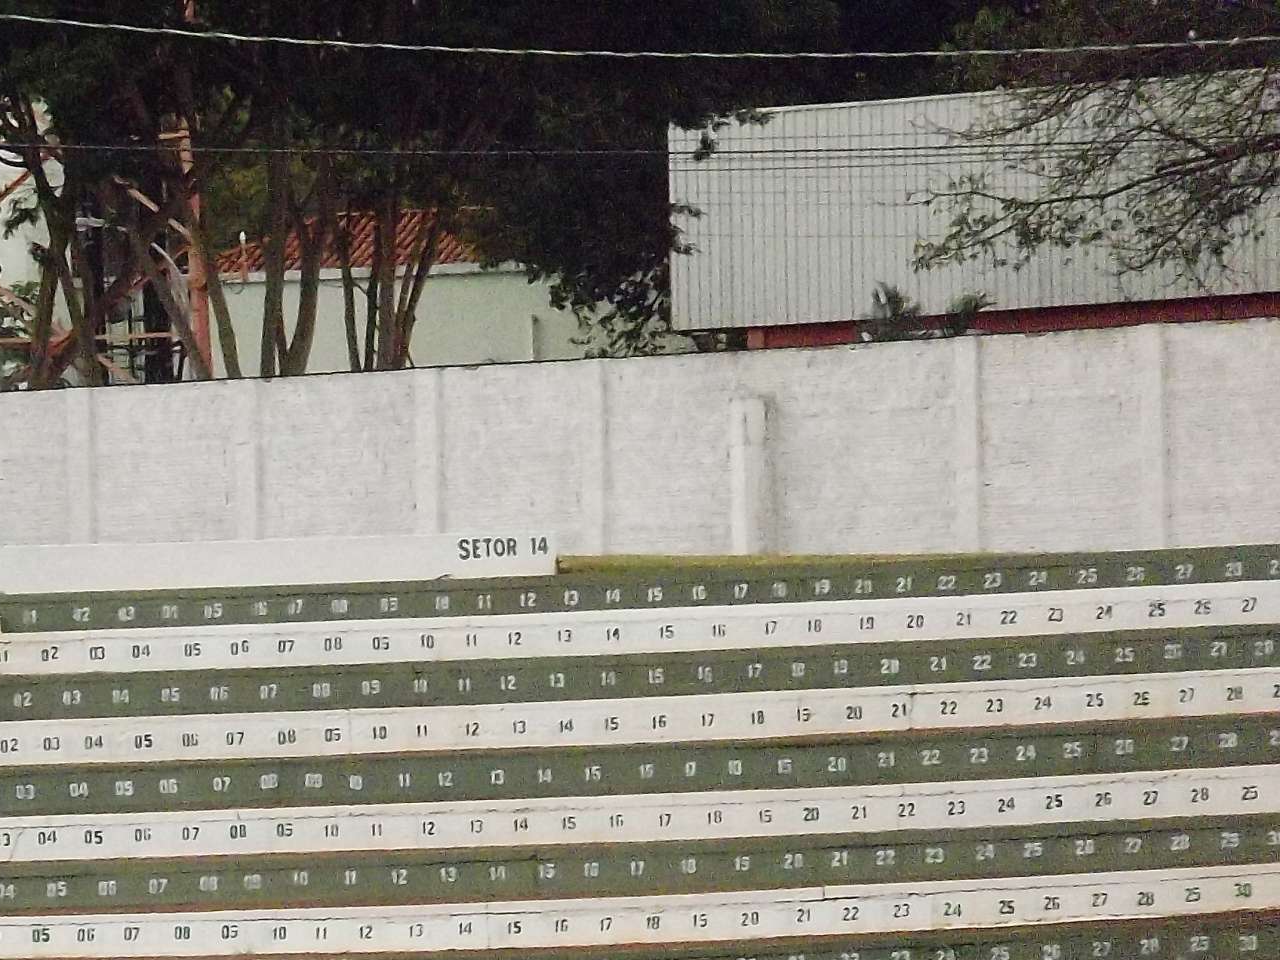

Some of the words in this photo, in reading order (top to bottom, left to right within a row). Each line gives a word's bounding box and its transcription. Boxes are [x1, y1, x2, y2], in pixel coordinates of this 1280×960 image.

[458, 537, 518, 560] SETOR
[530, 536, 549, 556] 14
[40, 645, 59, 662] 02
[89, 645, 106, 661] 03
[131, 644, 151, 659] 04
[183, 642, 202, 658] 05
[277, 639, 295, 654] 07
[465, 633, 478, 648] 11
[507, 631, 522, 646] 12
[557, 629, 573, 643] 13
[606, 627, 620, 642] 14
[659, 624, 675, 640] 15
[764, 620, 779, 636] 17
[955, 611, 972, 627] 21
[1000, 609, 1018, 625] 22
[1047, 607, 1064, 623] 23
[1095, 605, 1113, 621] 24
[1147, 601, 1167, 618] 25
[1241, 596, 1258, 614] 27
[0, 737, 19, 754] 02
[42, 736, 61, 752] 03
[84, 735, 104, 750] 04
[134, 733, 153, 750] 05
[225, 731, 245, 746] 07
[416, 724, 428, 738] 11
[465, 722, 480, 737] 12
[512, 720, 527, 735] 13
[558, 718, 575, 734] 14
[604, 716, 620, 732] 15
[701, 712, 715, 728] 17
[891, 702, 907, 719] 21
[939, 700, 958, 716] 22
[985, 698, 1004, 713] 23
[1033, 695, 1053, 711] 24
[1085, 692, 1104, 708] 25
[1178, 687, 1195, 704] 27
[37, 830, 58, 846] 04
[84, 829, 103, 845] 05
[181, 826, 200, 841] 07
[371, 823, 383, 837] 11
[422, 821, 436, 836] 12
[470, 819, 484, 834] 13
[513, 817, 529, 833] 14
[561, 815, 577, 831] 15
[658, 813, 672, 828] 17
[850, 805, 867, 821] 21
[897, 802, 916, 818] 22
[947, 800, 966, 816] 23
[997, 796, 1016, 814] 24
[1045, 793, 1063, 810] 25
[1142, 790, 1159, 806] 27
[31, 927, 51, 943] 05
[123, 926, 141, 942] 07
[315, 926, 328, 940] 11
[359, 924, 374, 940] 12
[409, 923, 425, 939] 13
[458, 921, 473, 936] 14
[507, 920, 522, 935] 15
[599, 916, 613, 933] 17
[796, 908, 811, 923] 21
[841, 906, 860, 922] 22
[892, 903, 911, 919] 23
[943, 901, 963, 918] 24
[998, 899, 1015, 915] 25
[1091, 892, 1109, 908] 27
